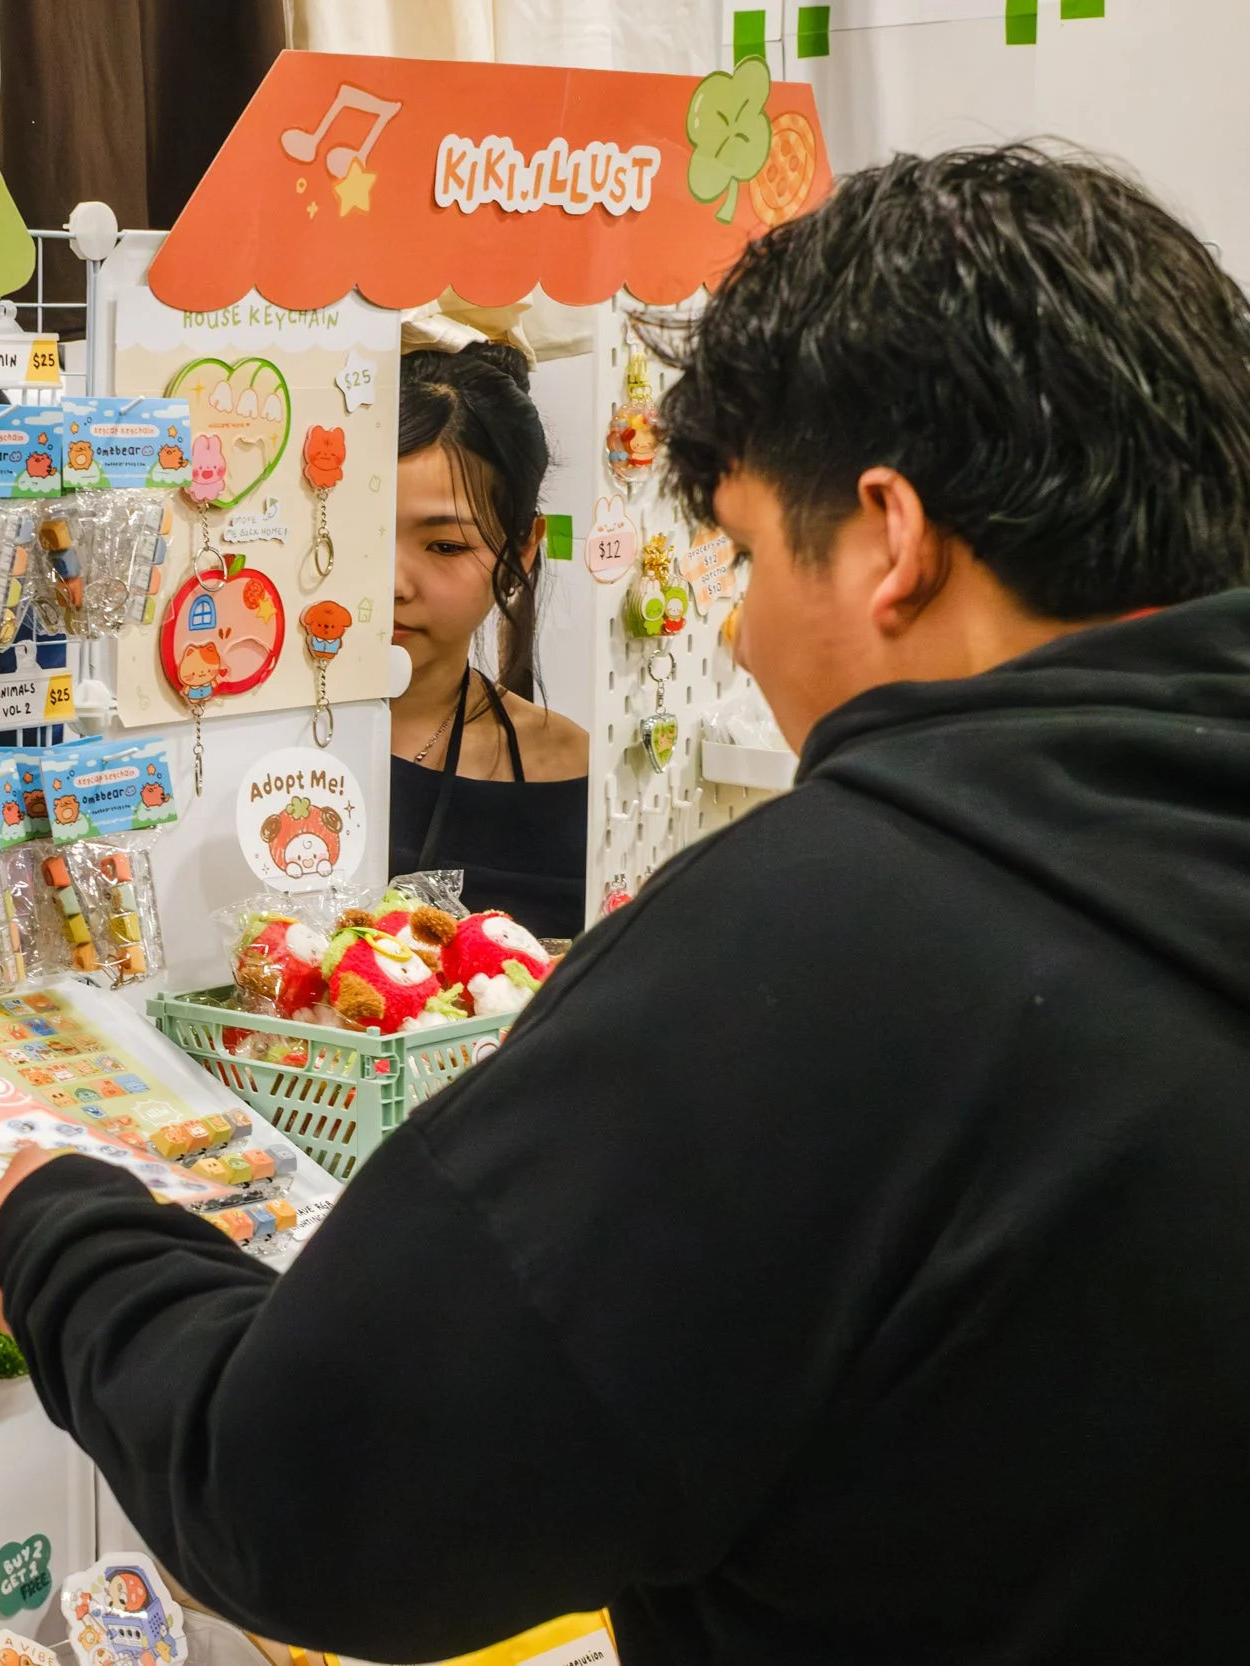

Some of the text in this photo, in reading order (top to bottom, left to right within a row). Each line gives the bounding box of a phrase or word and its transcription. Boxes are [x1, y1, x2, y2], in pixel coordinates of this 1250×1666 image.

[182, 304, 339, 331] HOUSE KEYCHAIN
[32, 351, 56, 369] $25
[344, 369, 372, 390] $25
[598, 539, 622, 561] $12
[48, 686, 71, 706] $25
[2, 702, 32, 717] VOL 2
[250, 769, 345, 803] Adopt Me!
[3, 1539, 44, 1575] BUY 2
[0, 1560, 39, 1595] GET 1
[19, 1571, 50, 1602] FREE
